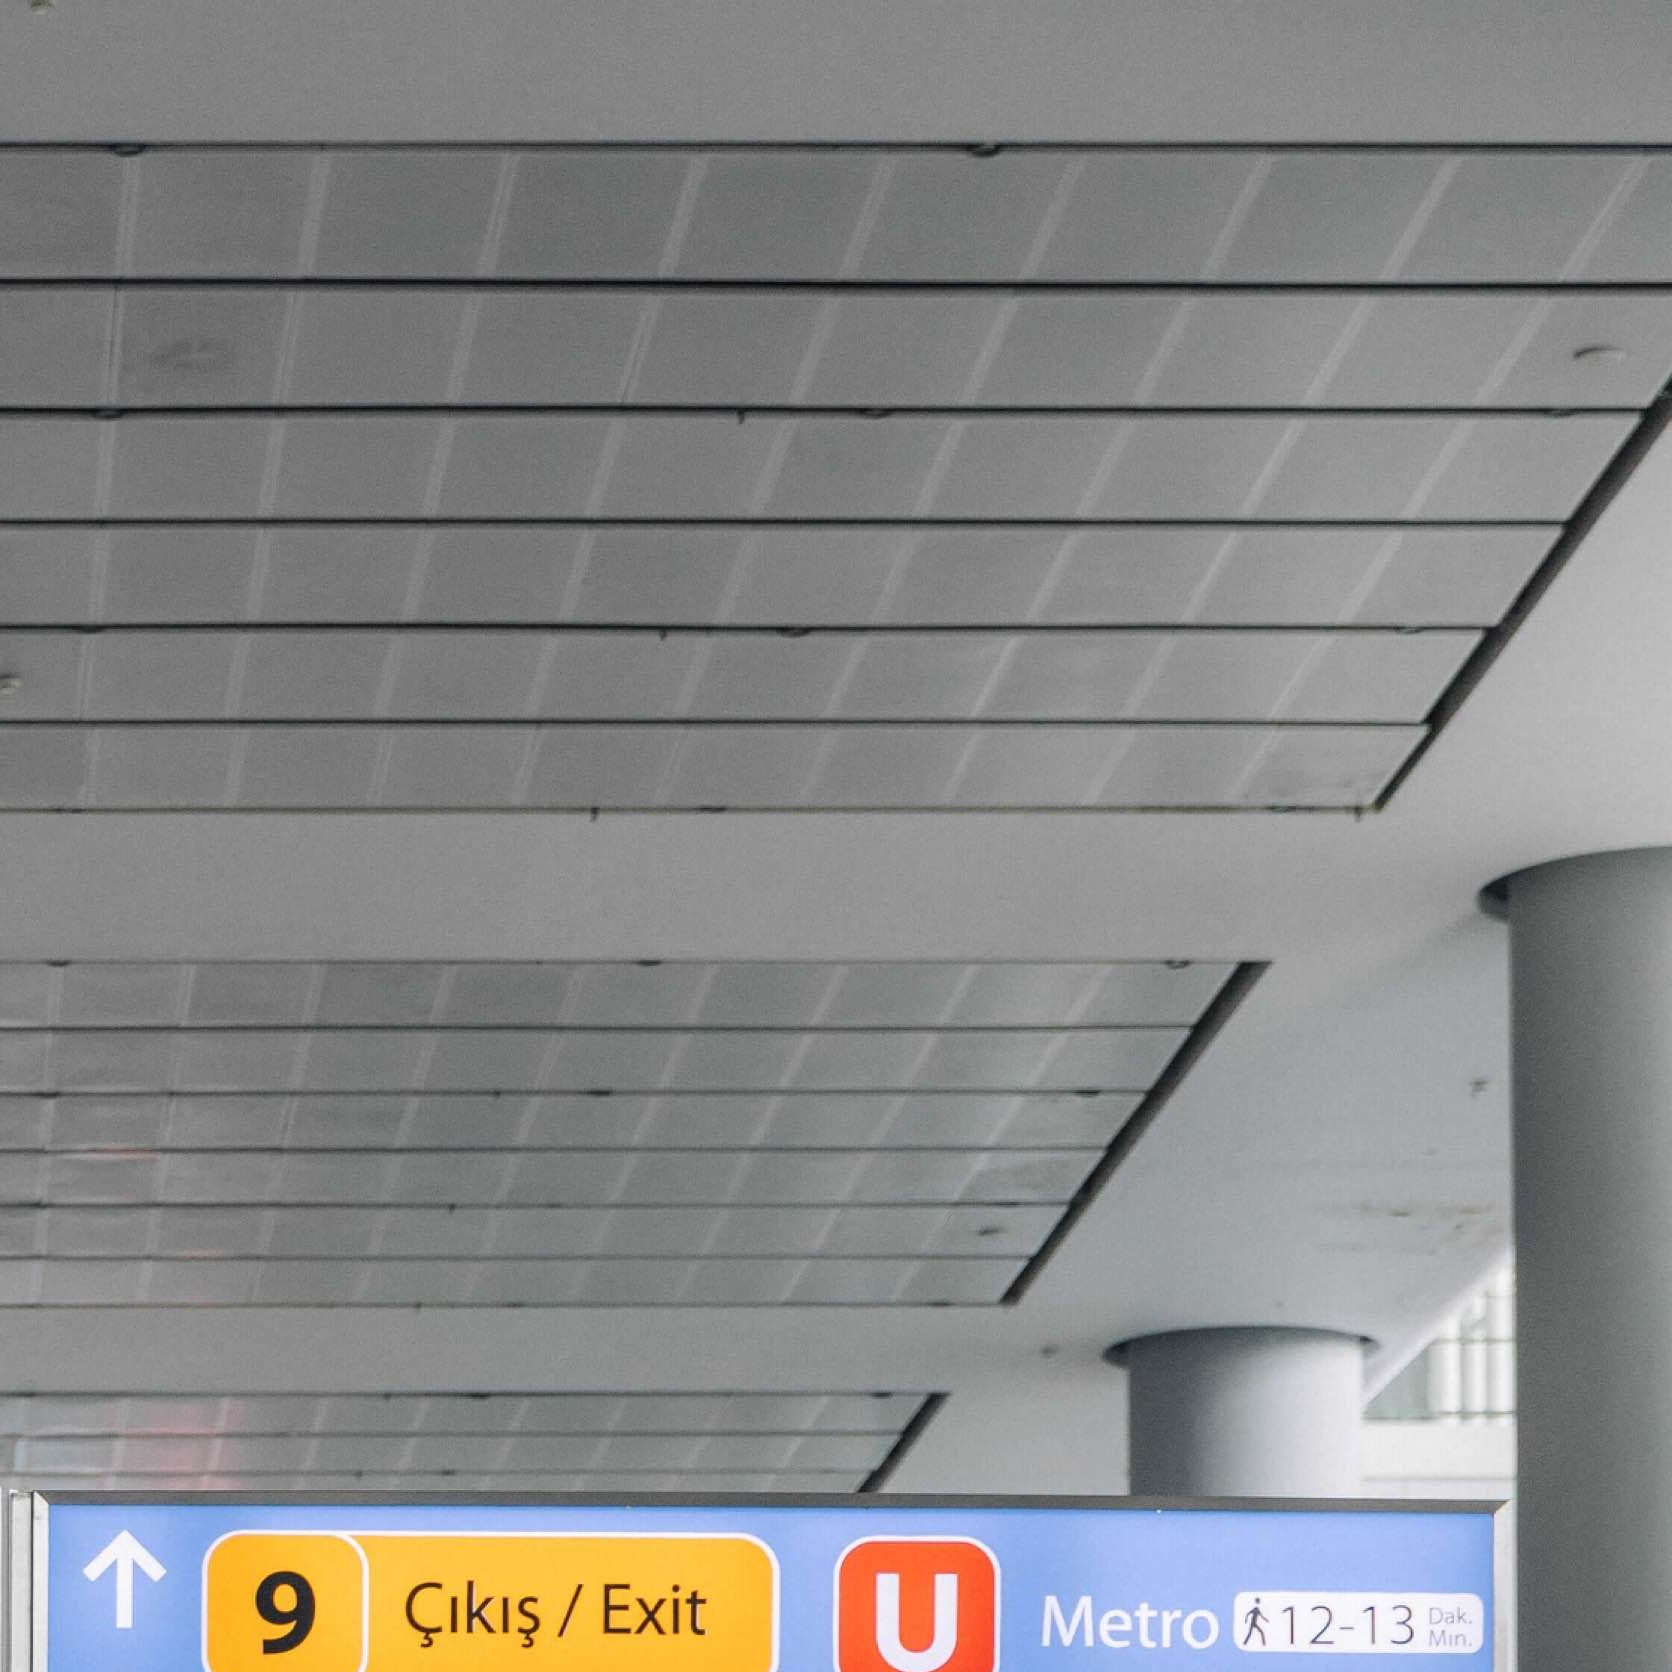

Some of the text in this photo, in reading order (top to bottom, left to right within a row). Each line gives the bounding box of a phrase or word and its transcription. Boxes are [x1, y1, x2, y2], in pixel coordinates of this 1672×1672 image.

[255, 1571, 707, 1655] 9 Çıkış / Exit
[1042, 1595, 1221, 1650] Metro
[1282, 1604, 1415, 1645] 12-13
[1429, 1606, 1473, 1625] Dak.
